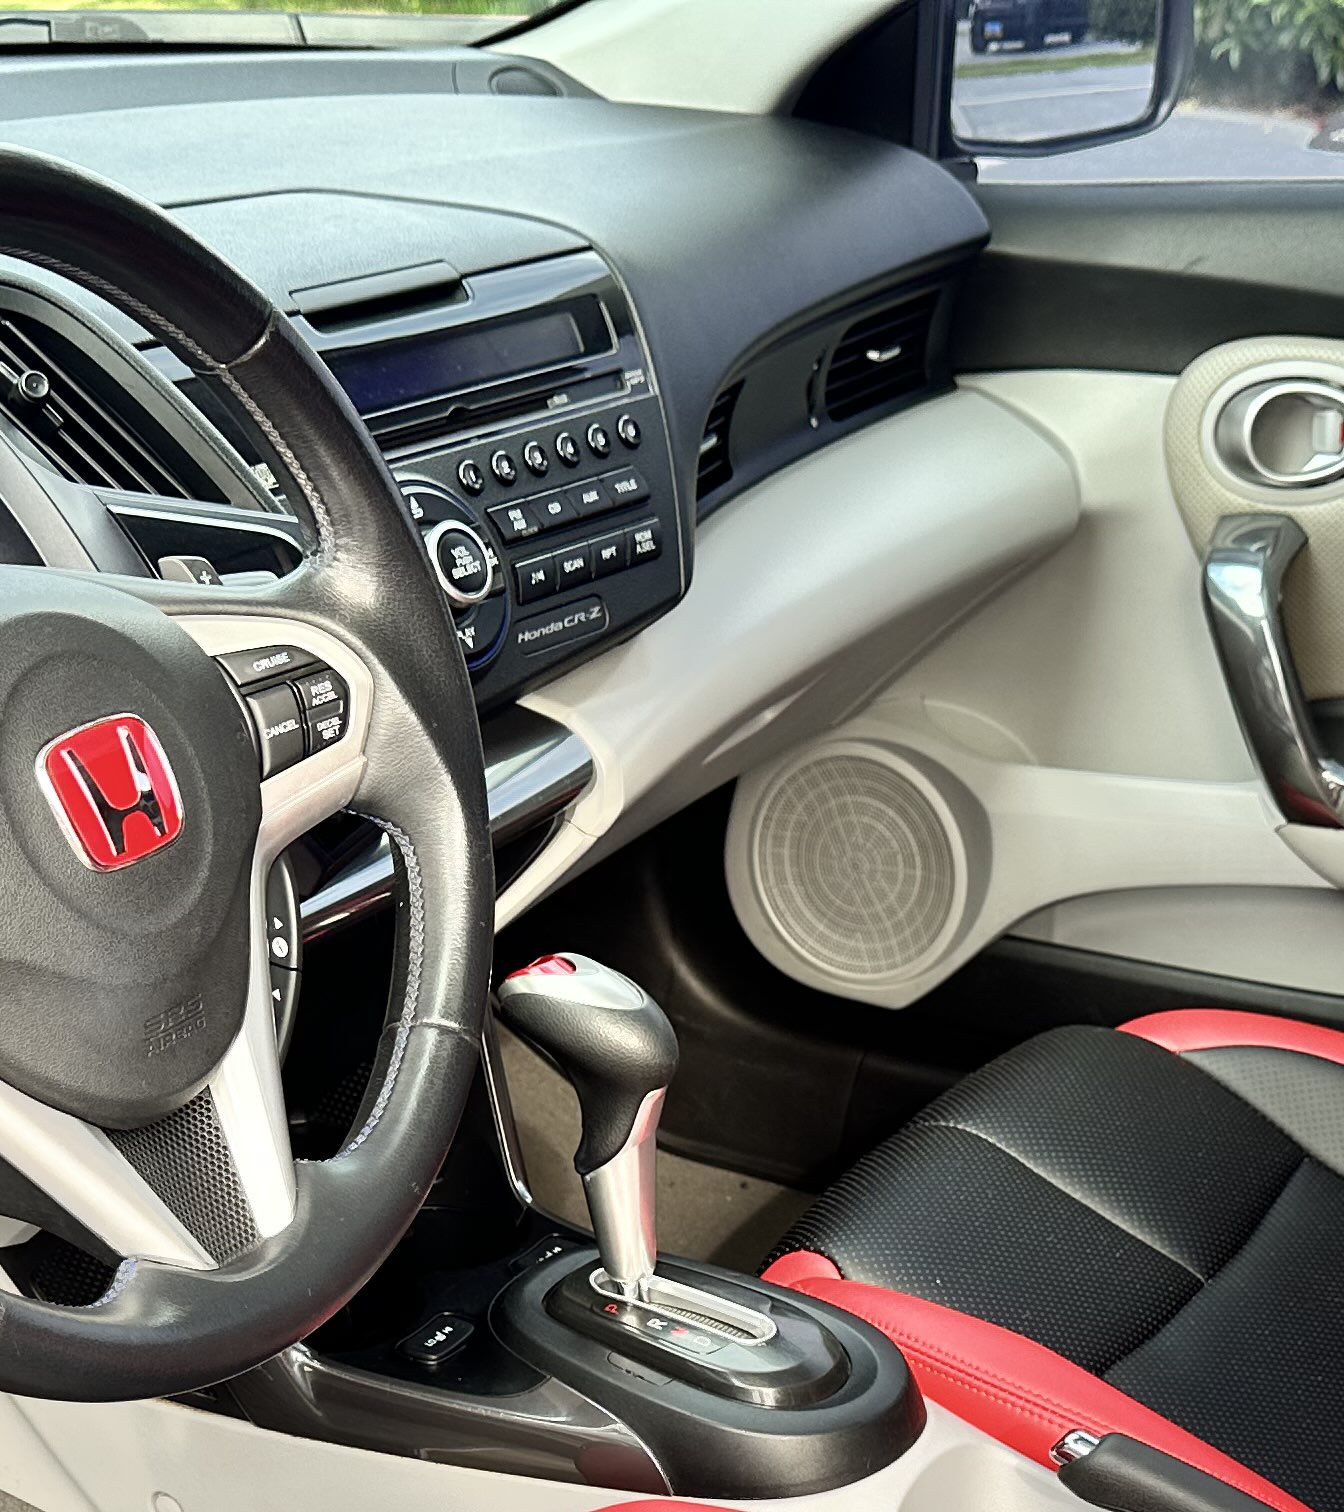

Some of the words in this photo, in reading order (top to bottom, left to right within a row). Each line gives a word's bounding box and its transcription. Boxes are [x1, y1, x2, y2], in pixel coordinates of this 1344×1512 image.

[614, 478, 638, 494] TITLE
[451, 560, 482, 580] SELECT
[563, 557, 584, 573] SCAN
[517, 621, 563, 644] Honda
[563, 606, 603, 628] CR-Z
[252, 651, 291, 672] CRUISE
[310, 680, 333, 696] RES
[311, 691, 339, 707] ACCEL
[263, 719, 300, 740] CANCEL
[316, 716, 343, 732] DECEL
[321, 725, 340, 740] SET
[646, 1317, 668, 1331] R
